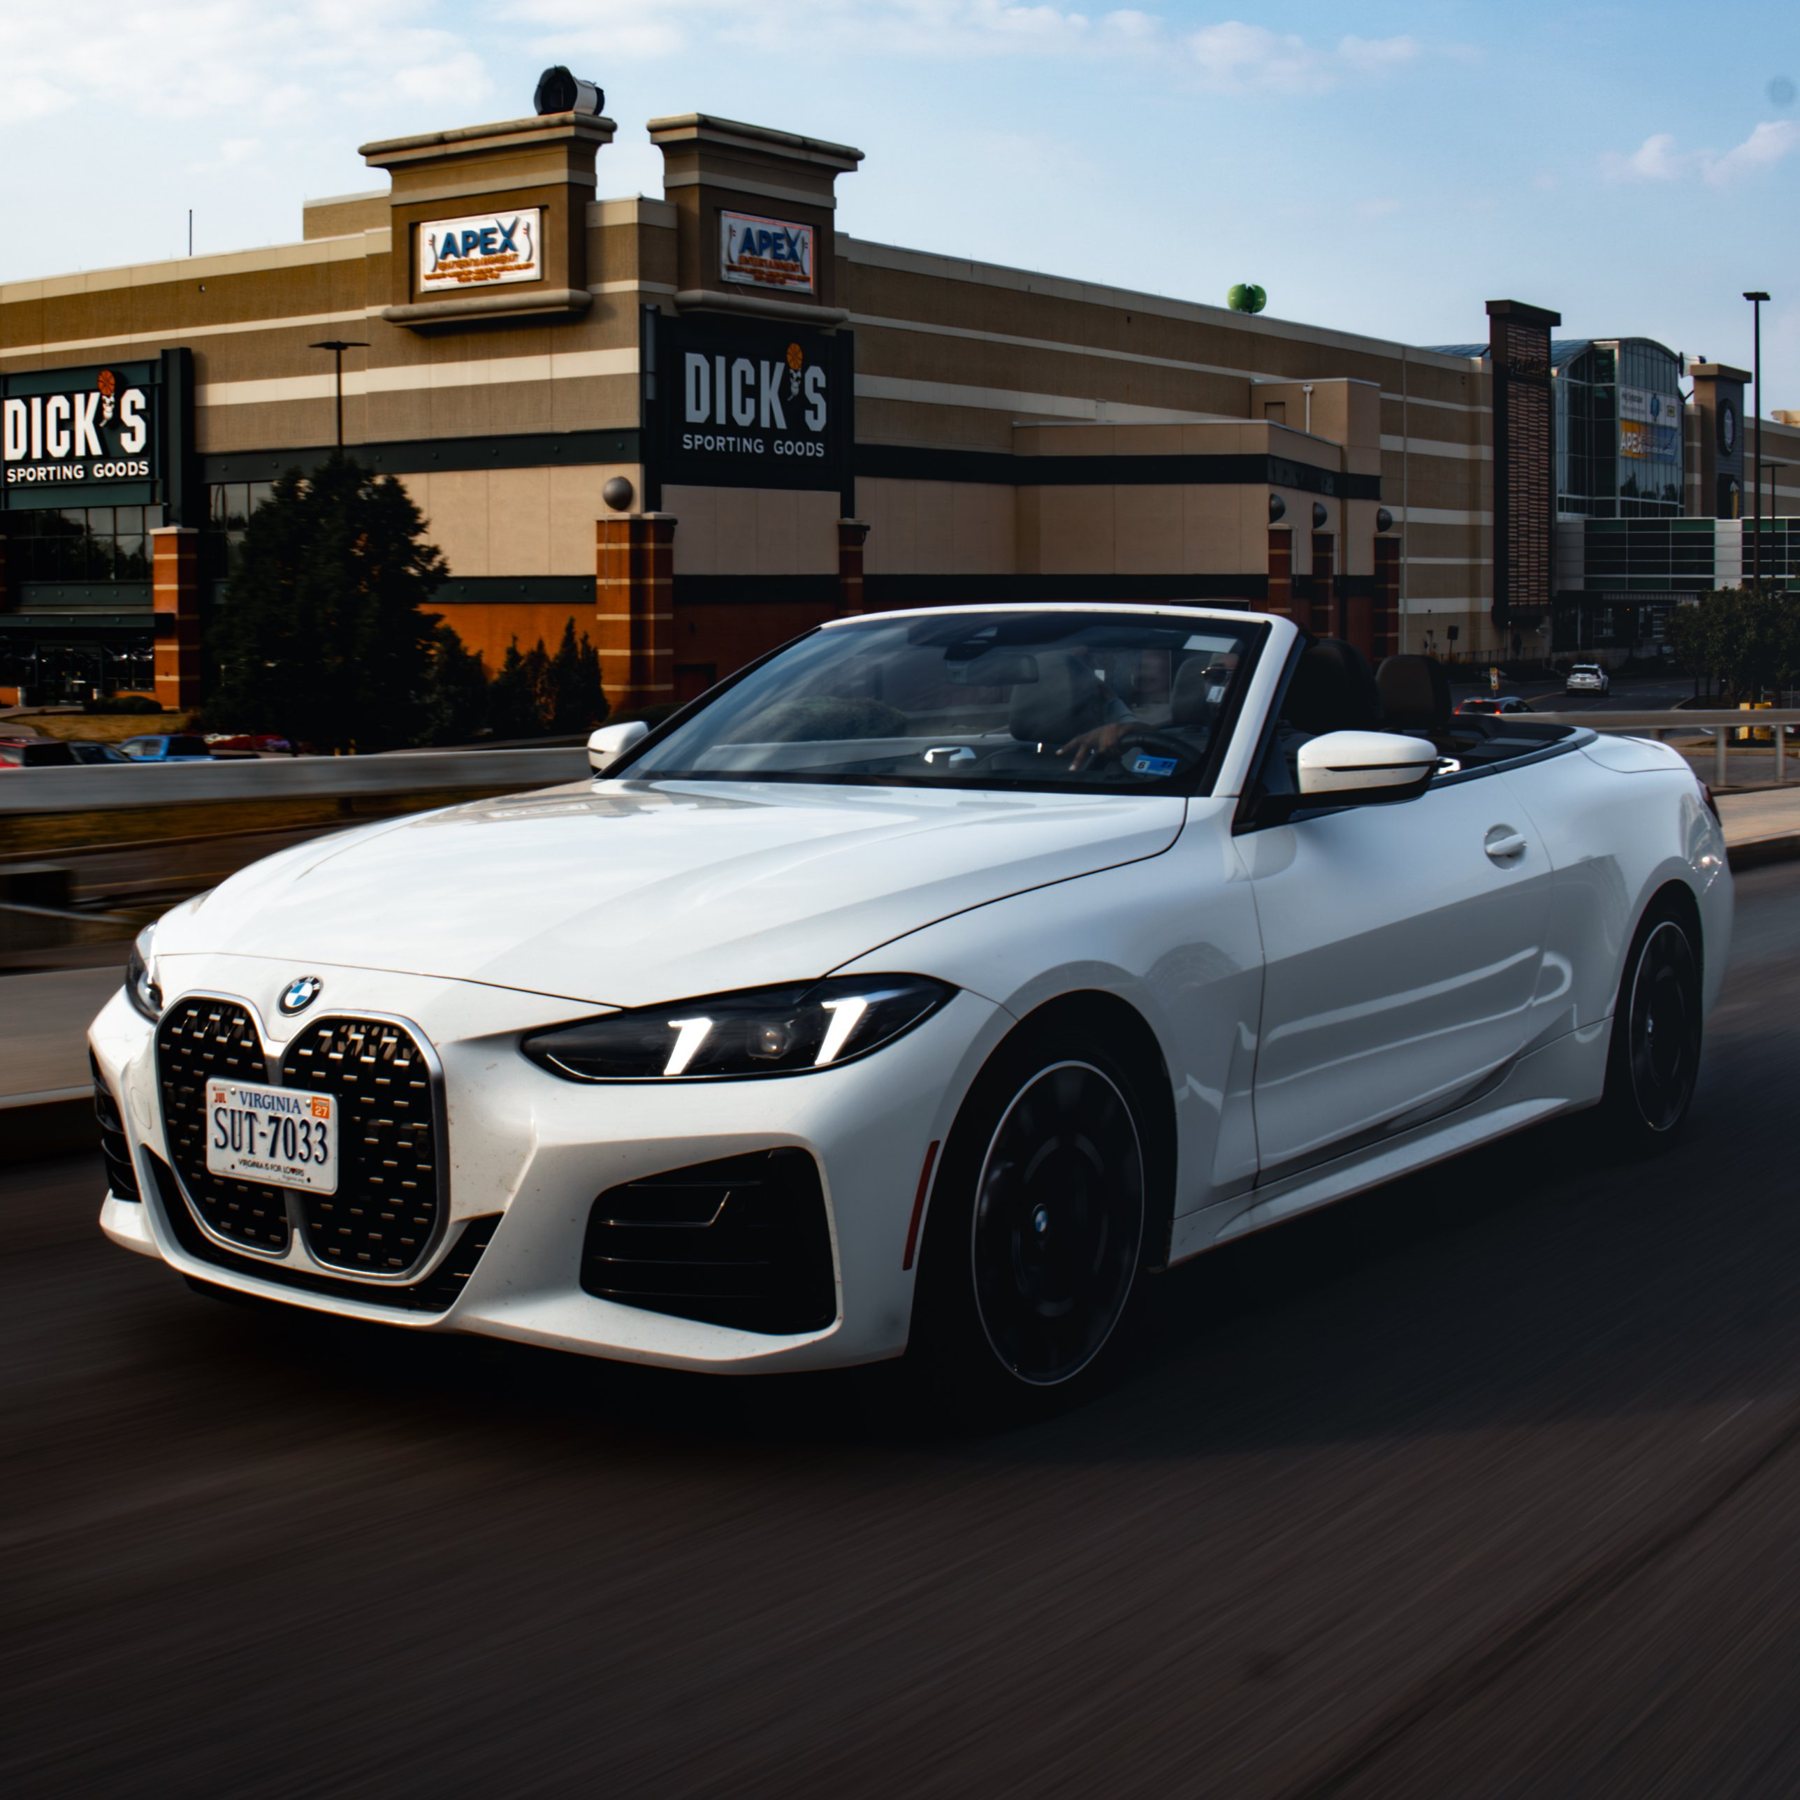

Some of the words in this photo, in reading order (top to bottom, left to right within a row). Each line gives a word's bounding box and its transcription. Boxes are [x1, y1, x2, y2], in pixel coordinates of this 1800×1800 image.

[439, 216, 520, 260] APEX
[739, 226, 801, 262] APEX
[685, 343, 826, 432] DICK'S
[4, 370, 147, 461] DICK'S
[683, 434, 764, 454] SPORTING
[774, 440, 824, 457] GOODS
[6, 465, 84, 483] SPORTING
[93, 461, 149, 478] GOODS
[239, 1091, 301, 1114] VIRGINIA
[315, 1105, 328, 1117] 27
[214, 1107, 329, 1164] SUT-7033
